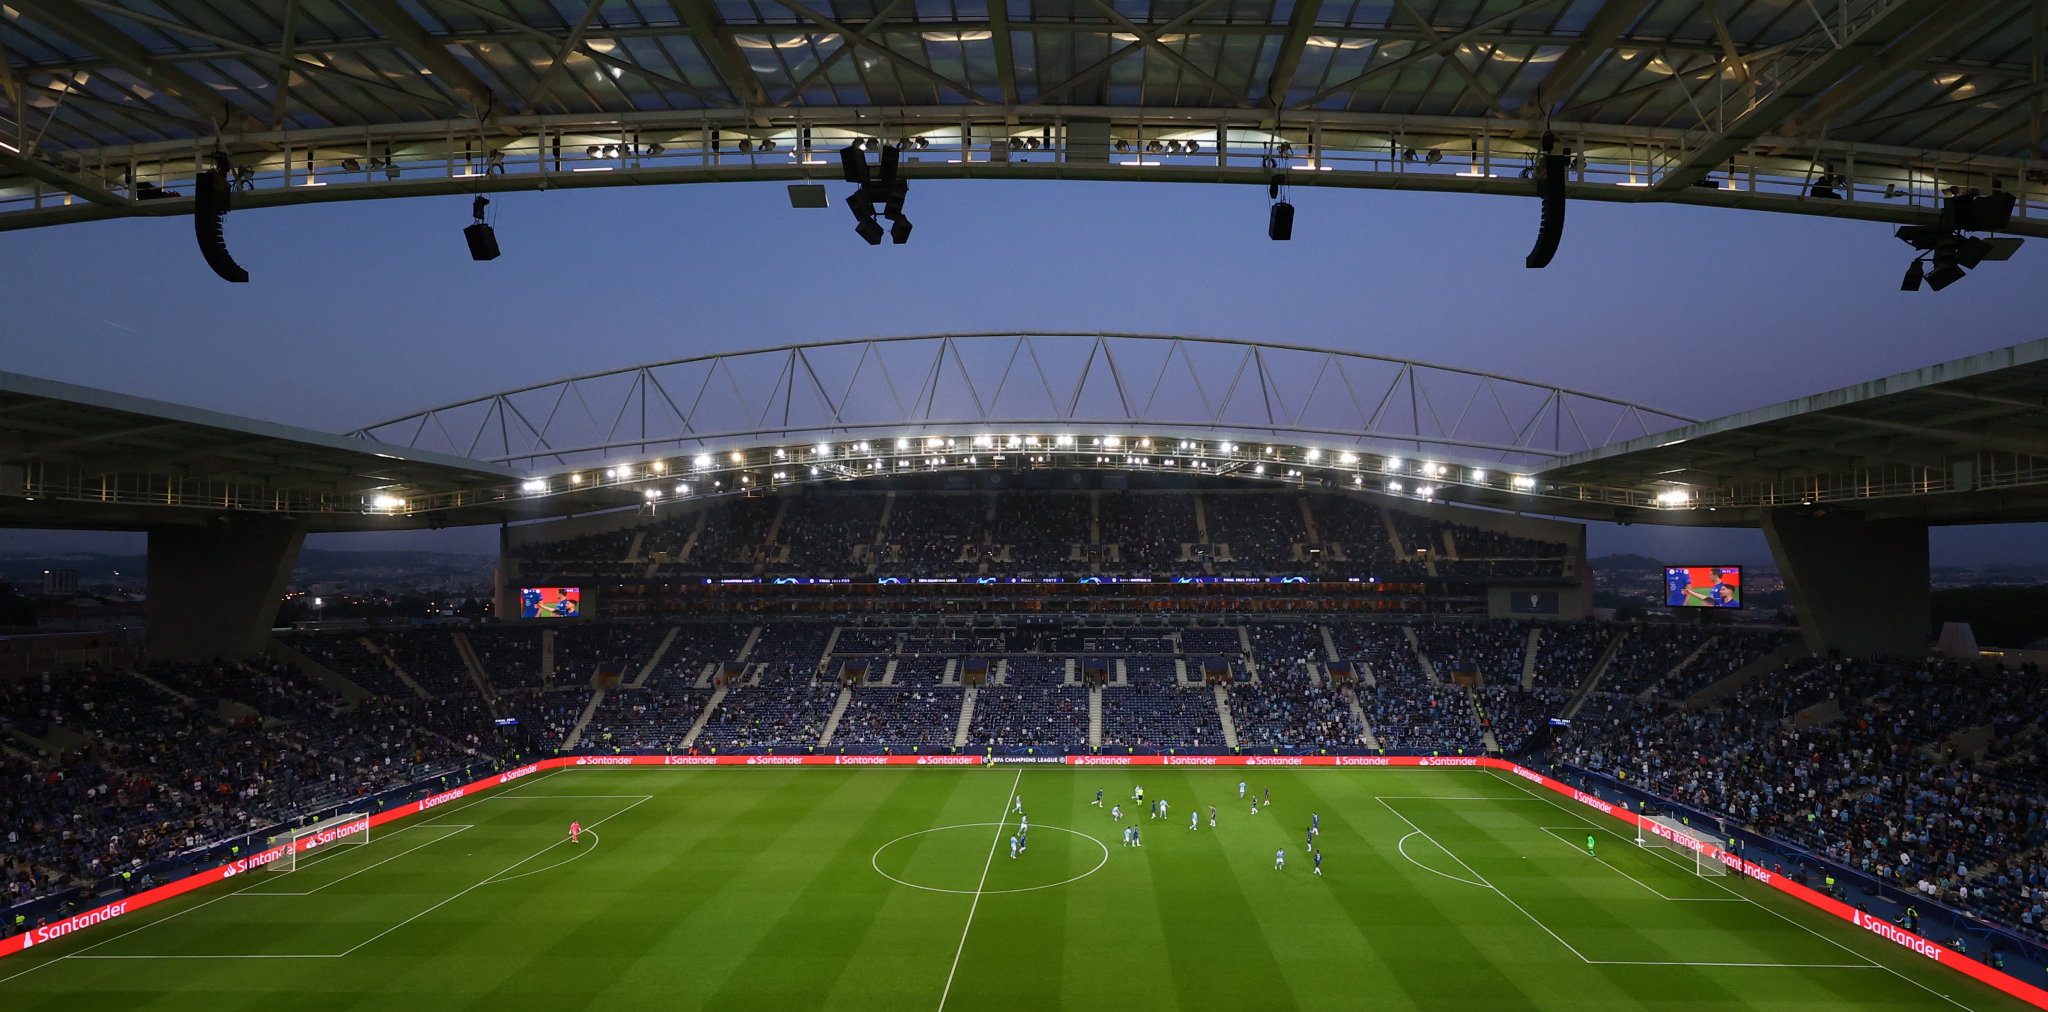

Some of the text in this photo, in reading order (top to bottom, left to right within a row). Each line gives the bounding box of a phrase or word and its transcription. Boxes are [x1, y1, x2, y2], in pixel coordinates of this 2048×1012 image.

[587, 756, 633, 765] Santander
[672, 756, 718, 765] Santander
[757, 755, 803, 765] Santander
[842, 755, 888, 765] Santander
[927, 755, 973, 765] Santander
[1084, 755, 1131, 765] Santander
[1170, 755, 1216, 765] Santander
[1256, 755, 1303, 765] Santander
[1342, 756, 1389, 766] Santander
[1429, 756, 1477, 766] Santander
[507, 764, 537, 781] Santander
[1518, 767, 1543, 784] Santander
[425, 788, 465, 809] Santander
[1578, 791, 1612, 814] Santander
[1720, 851, 1771, 883] Santander
[37, 902, 127, 943] Santander
[1863, 914, 1942, 960] Santander
